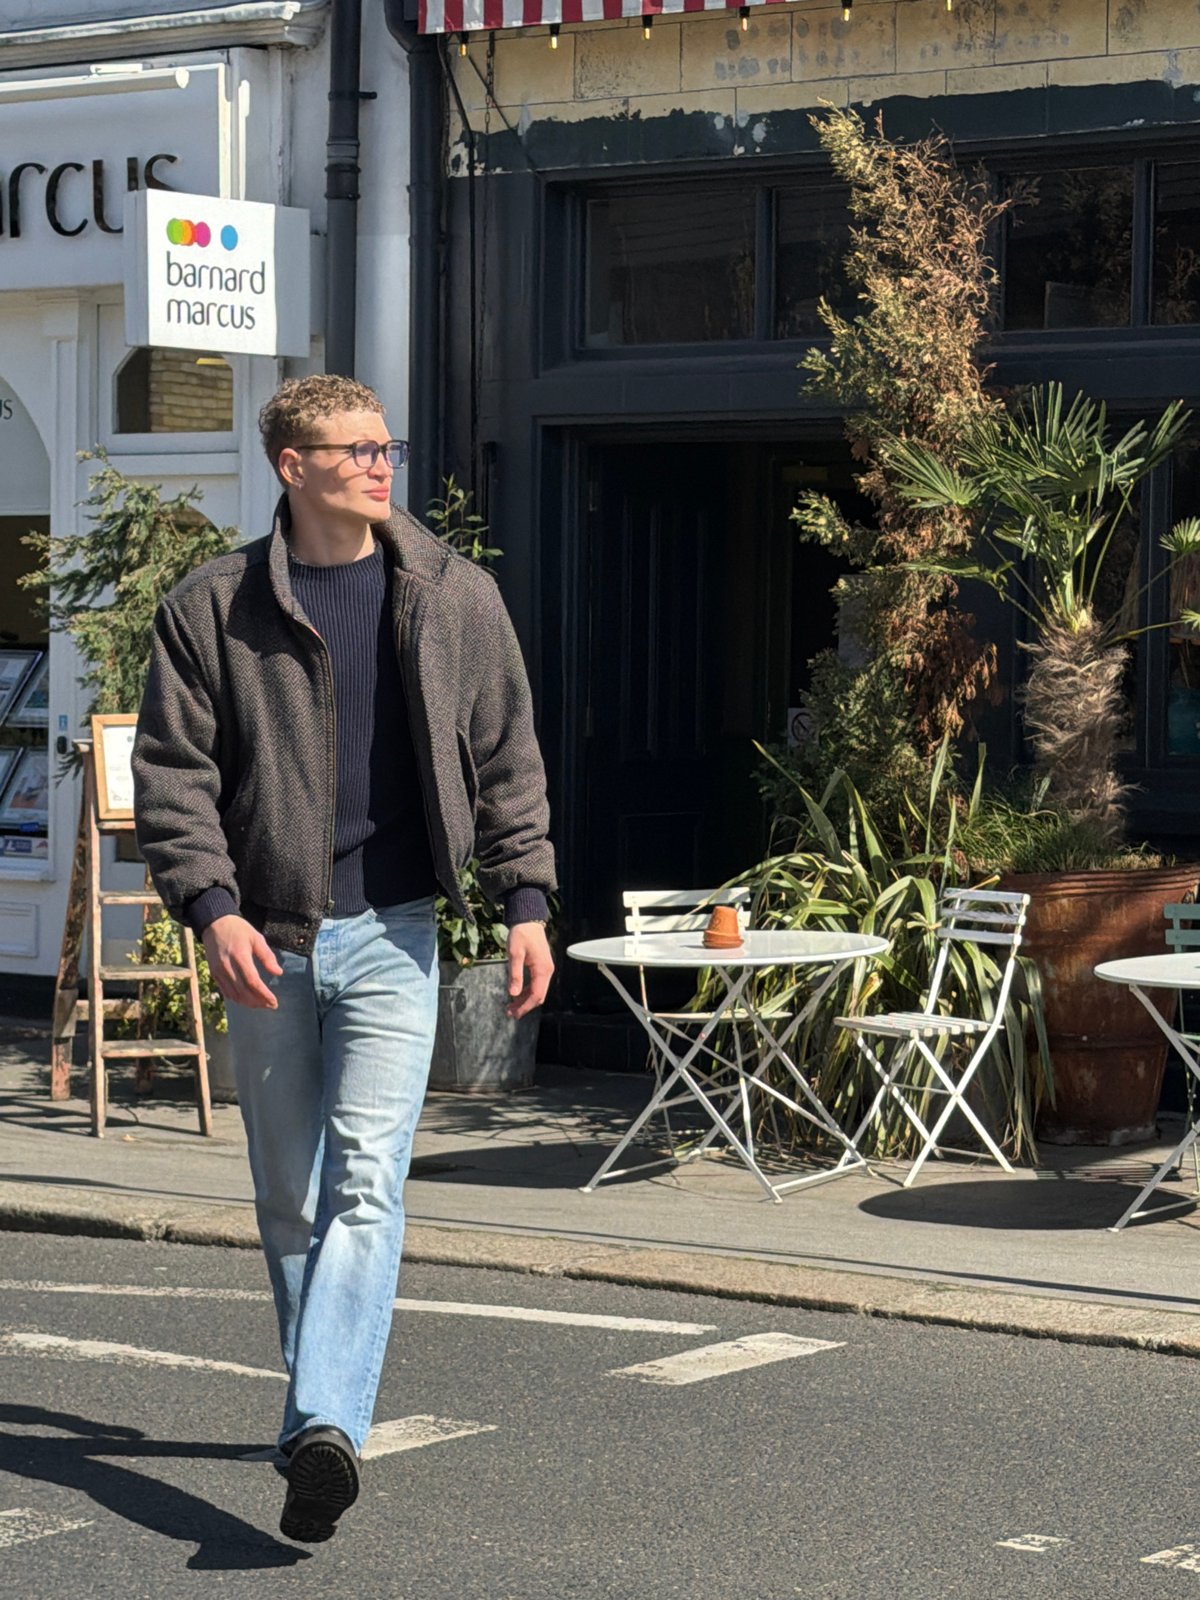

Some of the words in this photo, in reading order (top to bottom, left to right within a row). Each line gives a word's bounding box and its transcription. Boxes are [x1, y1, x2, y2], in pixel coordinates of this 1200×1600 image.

[0, 153, 178, 238] rcu
[166, 250, 265, 294] barnard
[166, 298, 256, 330] marcus
